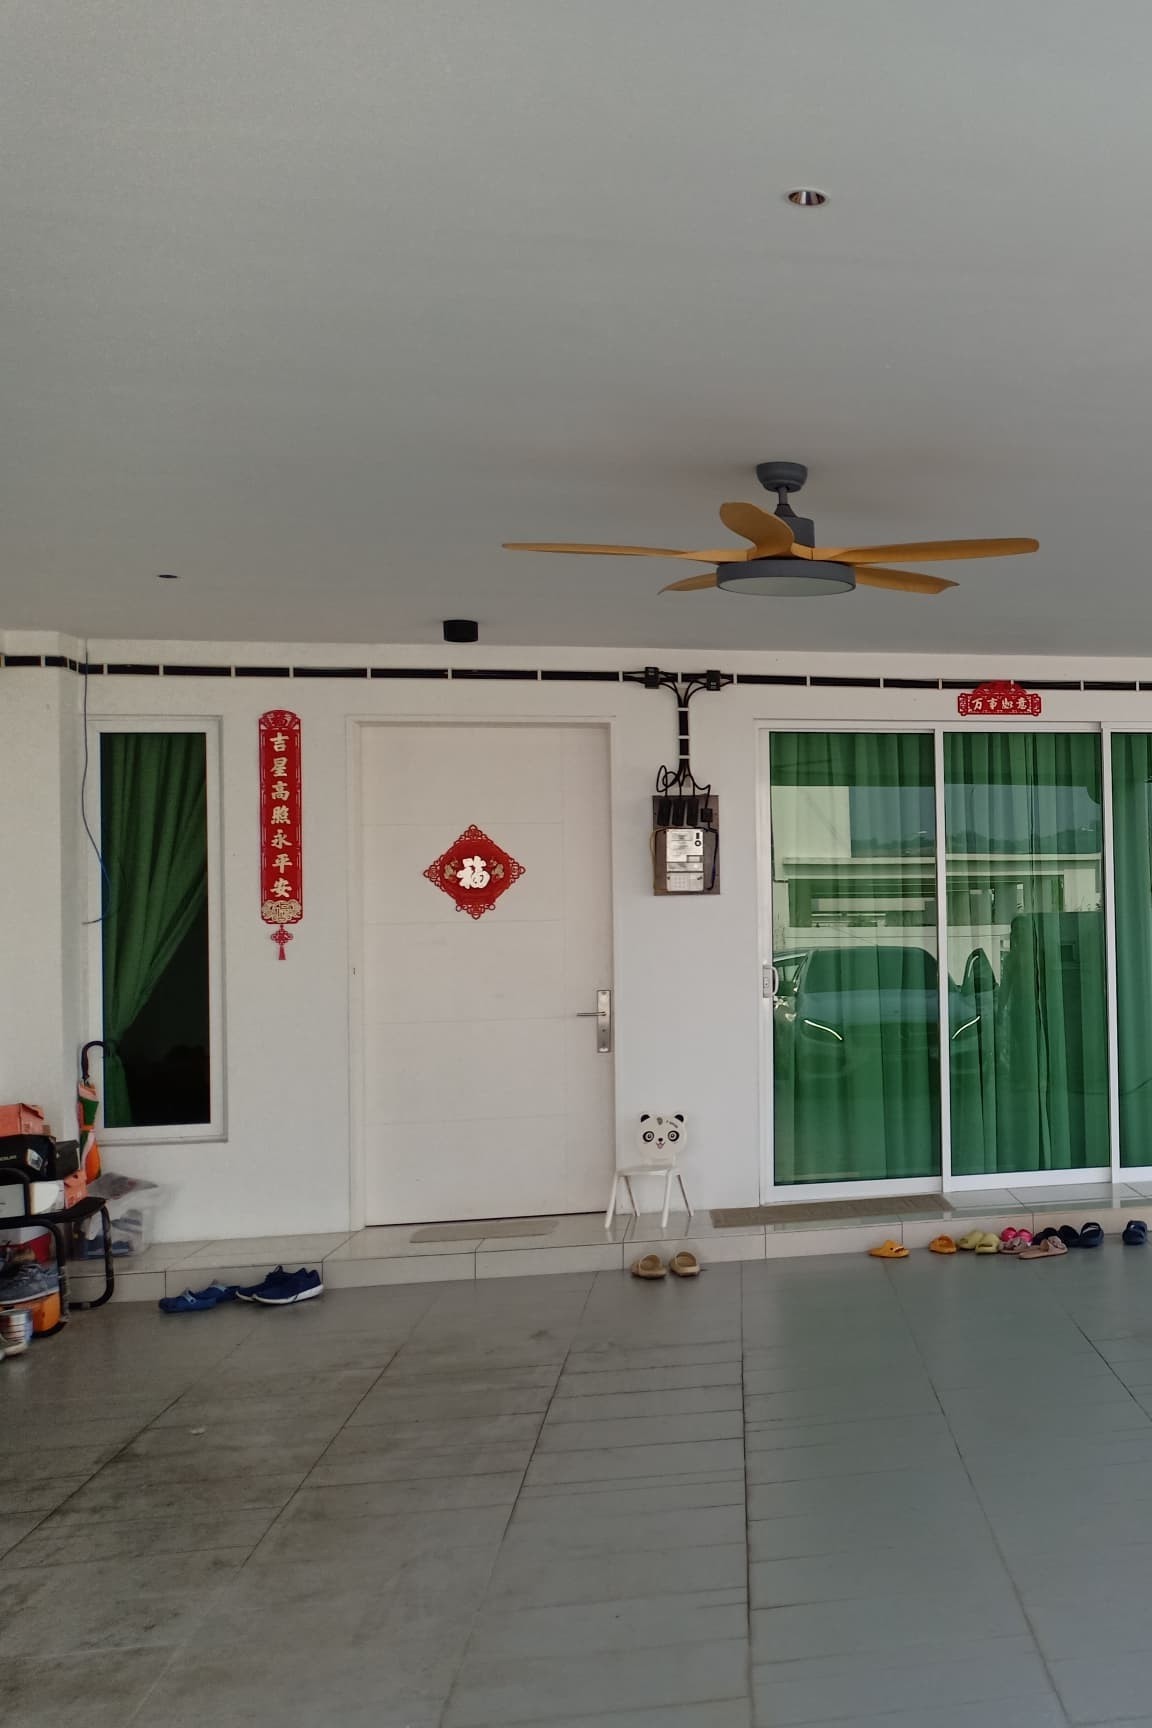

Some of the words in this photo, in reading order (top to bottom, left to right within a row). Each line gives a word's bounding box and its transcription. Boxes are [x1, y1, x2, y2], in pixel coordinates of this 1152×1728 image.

[971, 697, 1028, 711] 万事如意
[270, 731, 293, 898] 吉星高照永平安
[456, 855, 491, 889] 福
